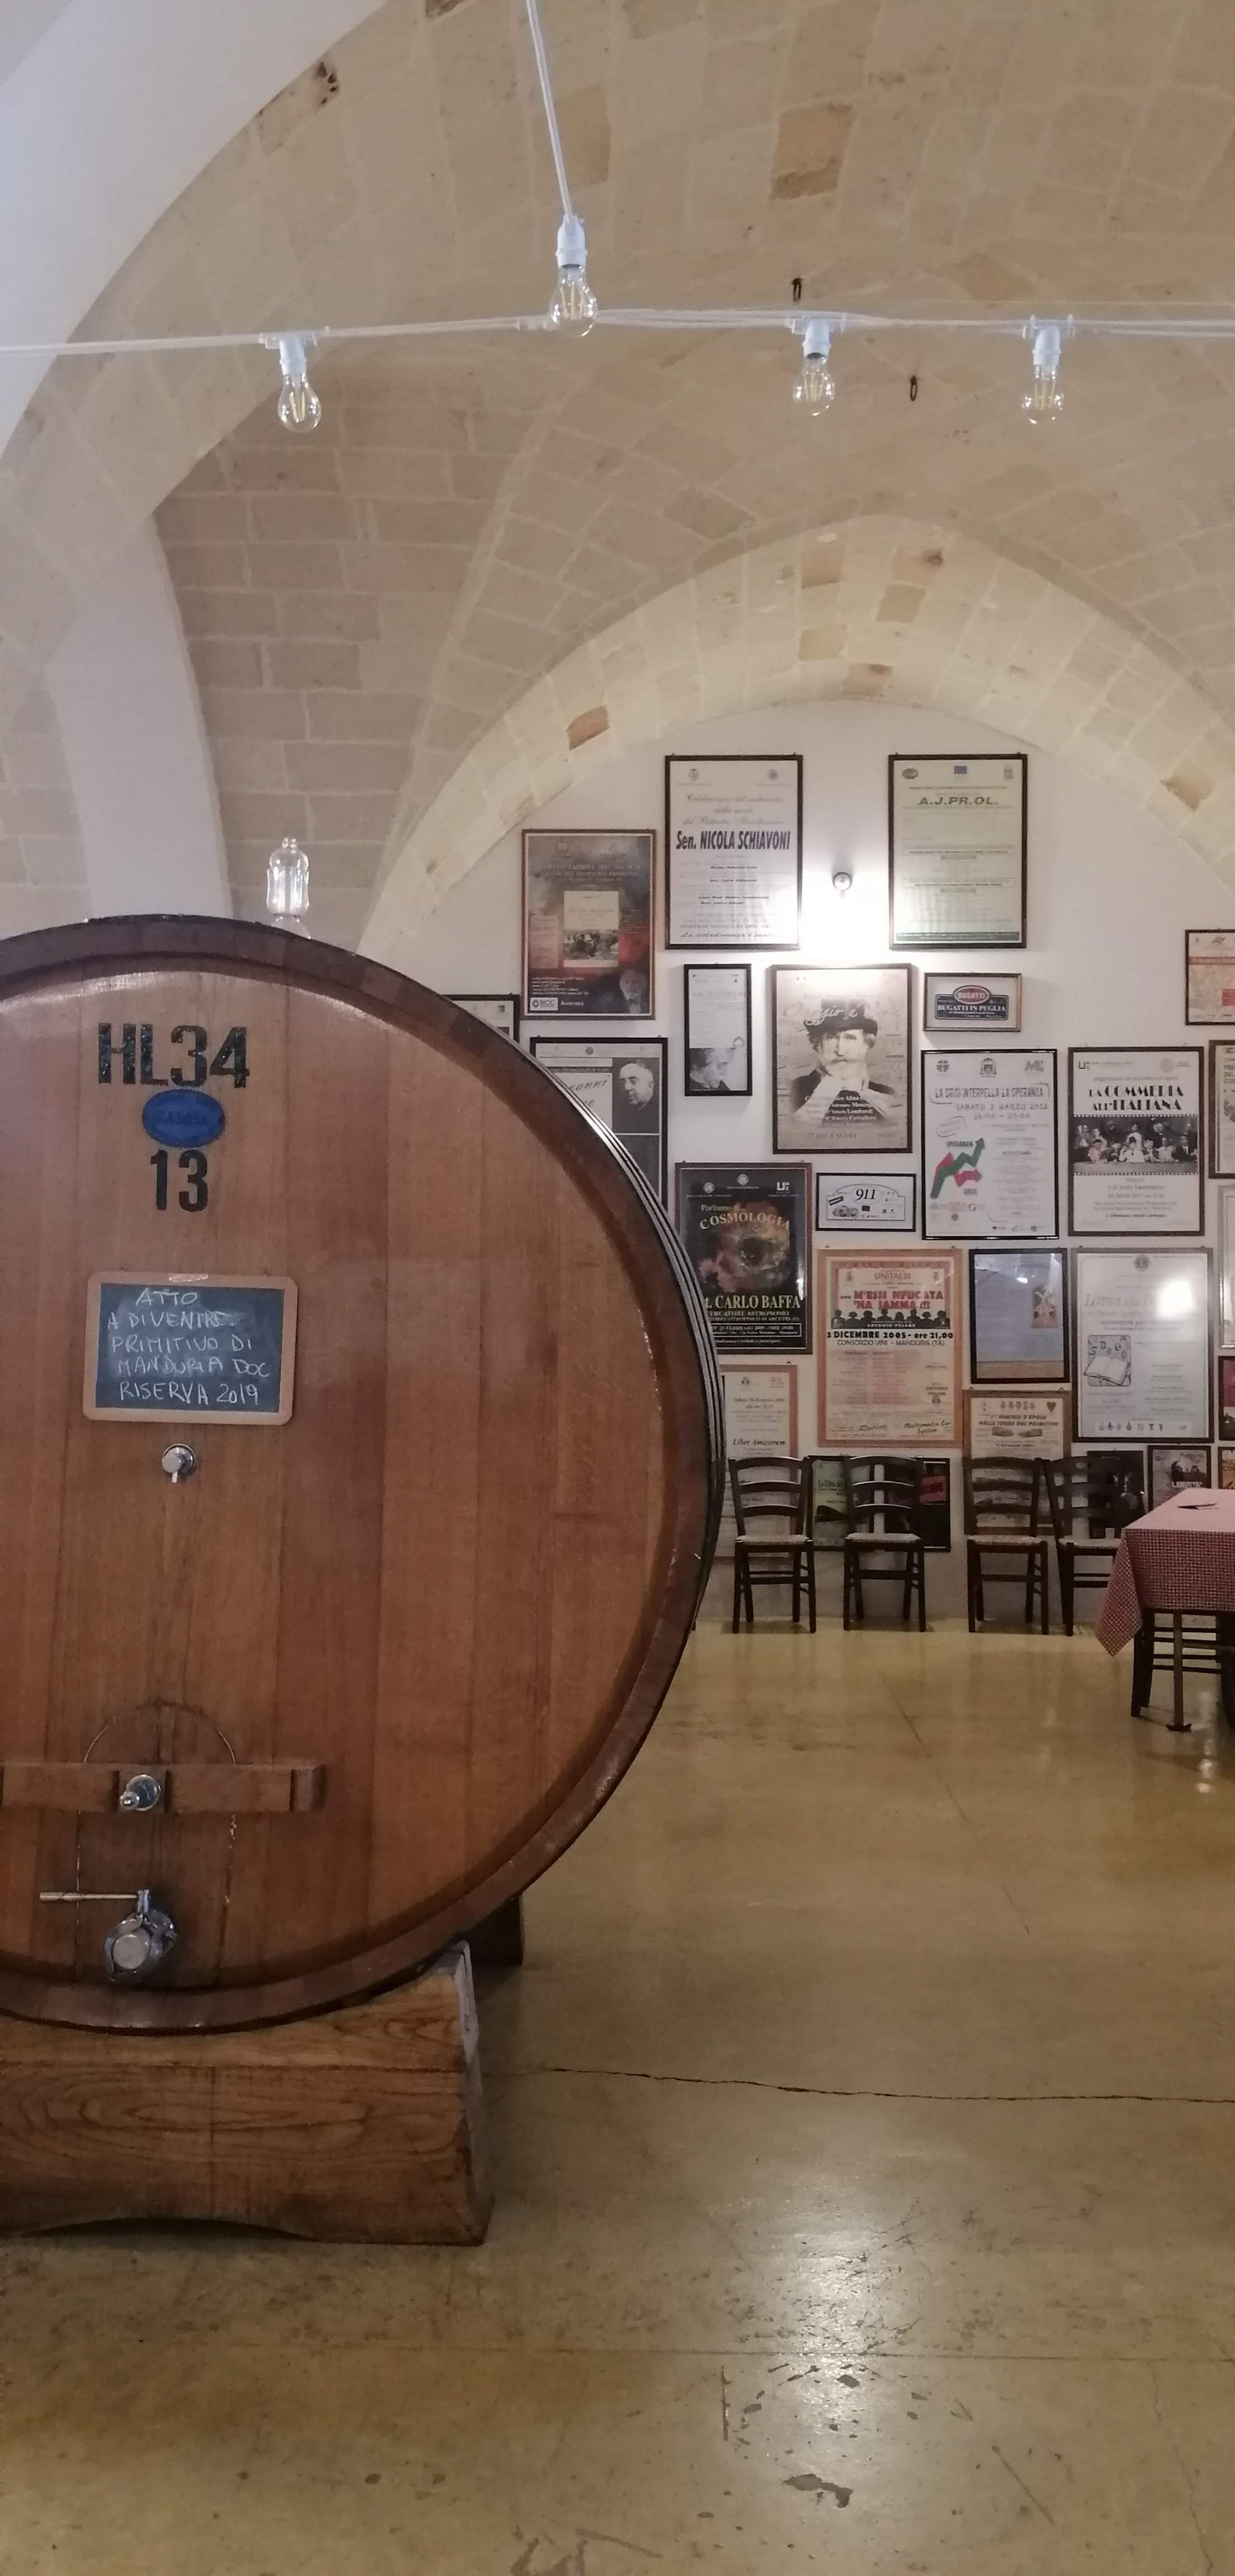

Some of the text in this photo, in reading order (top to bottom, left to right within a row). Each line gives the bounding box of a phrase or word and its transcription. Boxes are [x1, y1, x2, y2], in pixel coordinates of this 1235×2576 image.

[676, 831, 790, 849] Sen. NICOLA SCHIAVONI
[98, 1023, 250, 1088] HL34
[1011, 1087, 1043, 1097] SPERANZA
[1104, 1085, 1184, 1096] COMMEDIA
[151, 1149, 208, 1212] 13
[855, 1188, 876, 1201] 911
[700, 1212, 790, 1230] COSMOLOGIA
[874, 1272, 911, 1280] UNITALSI
[135, 1287, 198, 1306] ATTO
[715, 1295, 759, 1308] CARLO
[761, 1295, 801, 1308] BAFFA
[111, 1333, 252, 1354] PRIMITIVO DI
[119, 1356, 270, 1377] MANDURIA DOC
[119, 1381, 258, 1405] RISERVA 2019
